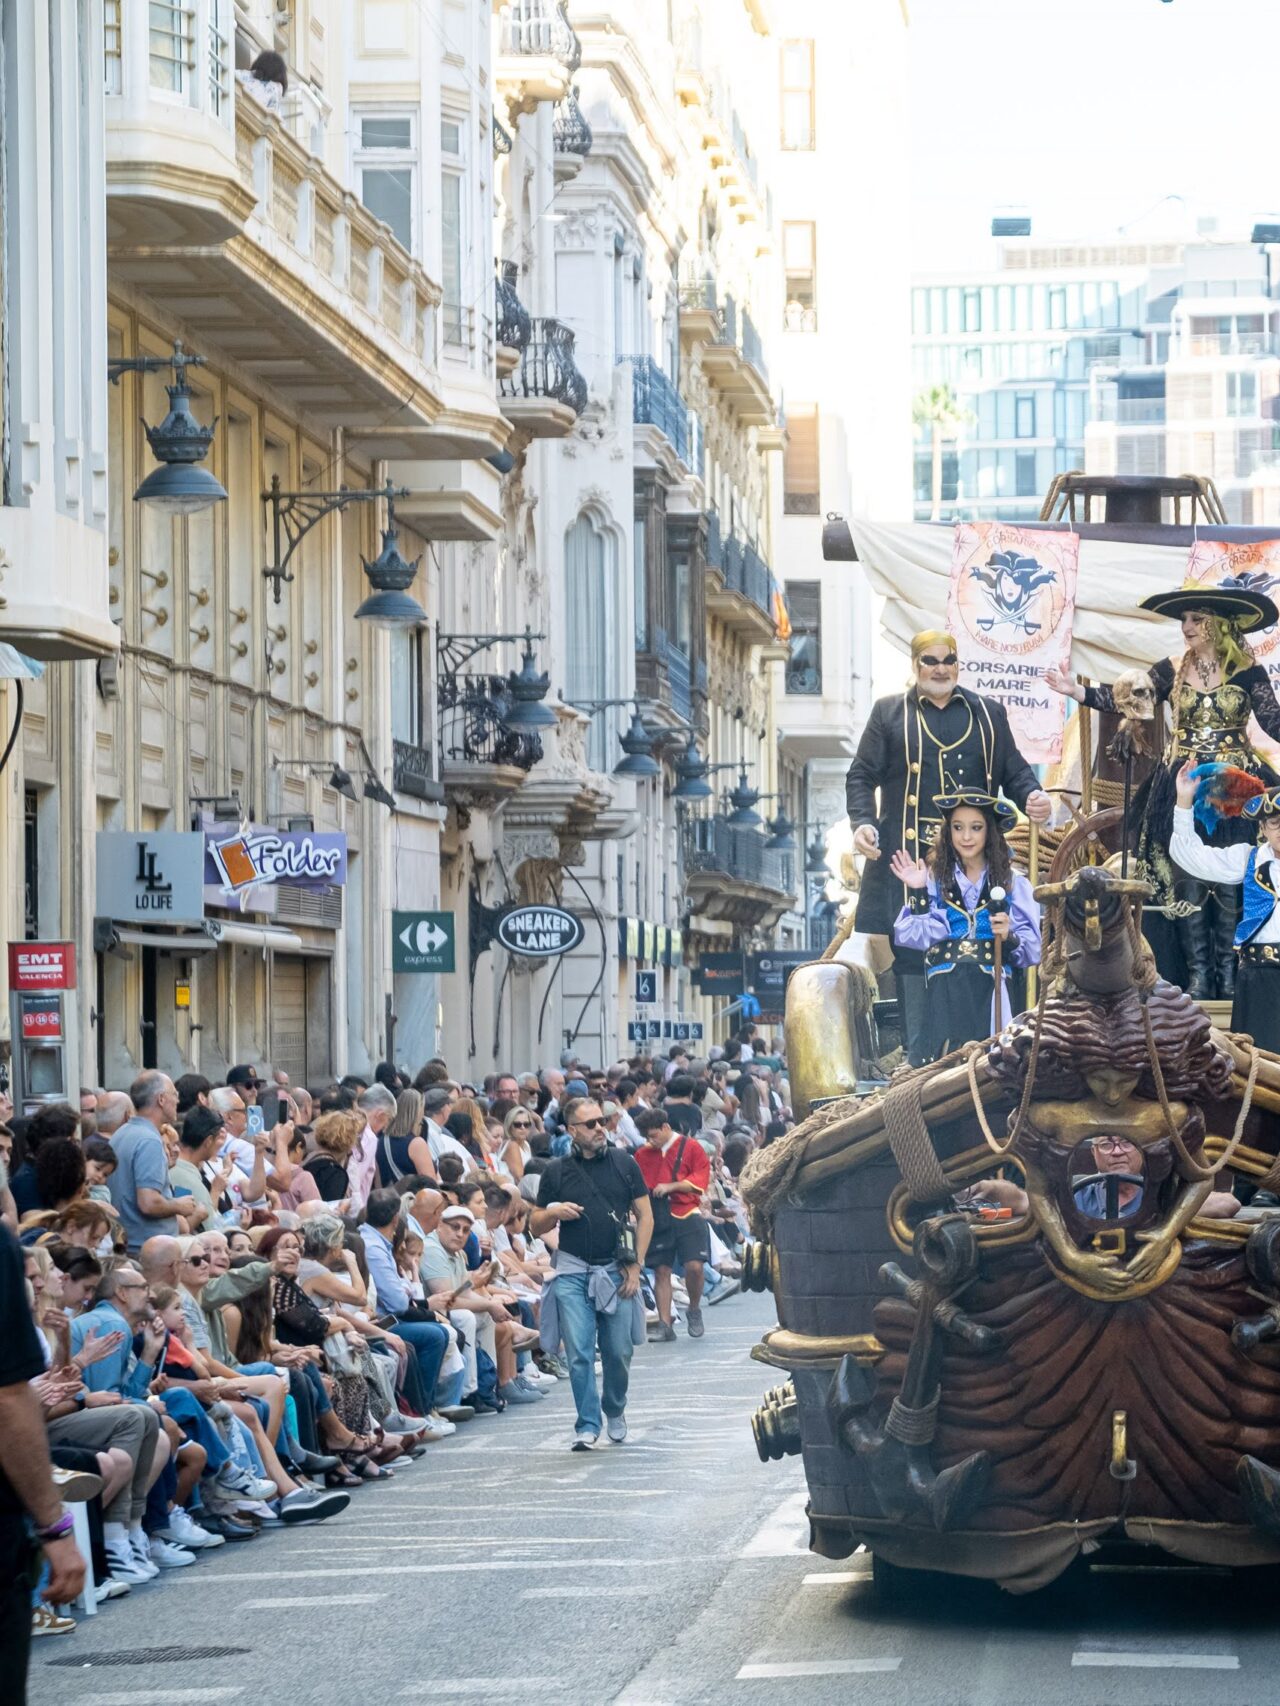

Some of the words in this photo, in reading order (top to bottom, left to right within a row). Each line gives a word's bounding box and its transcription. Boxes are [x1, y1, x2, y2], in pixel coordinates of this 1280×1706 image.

[976, 678, 1032, 692] MARE
[251, 837, 341, 878] Folder
[136, 895, 149, 909] LO
[151, 895, 173, 909] LIFE
[507, 913, 571, 932] SNEAKER
[516, 932, 562, 949] LANE
[18, 953, 63, 965] EMT
[404, 955, 443, 965] express
